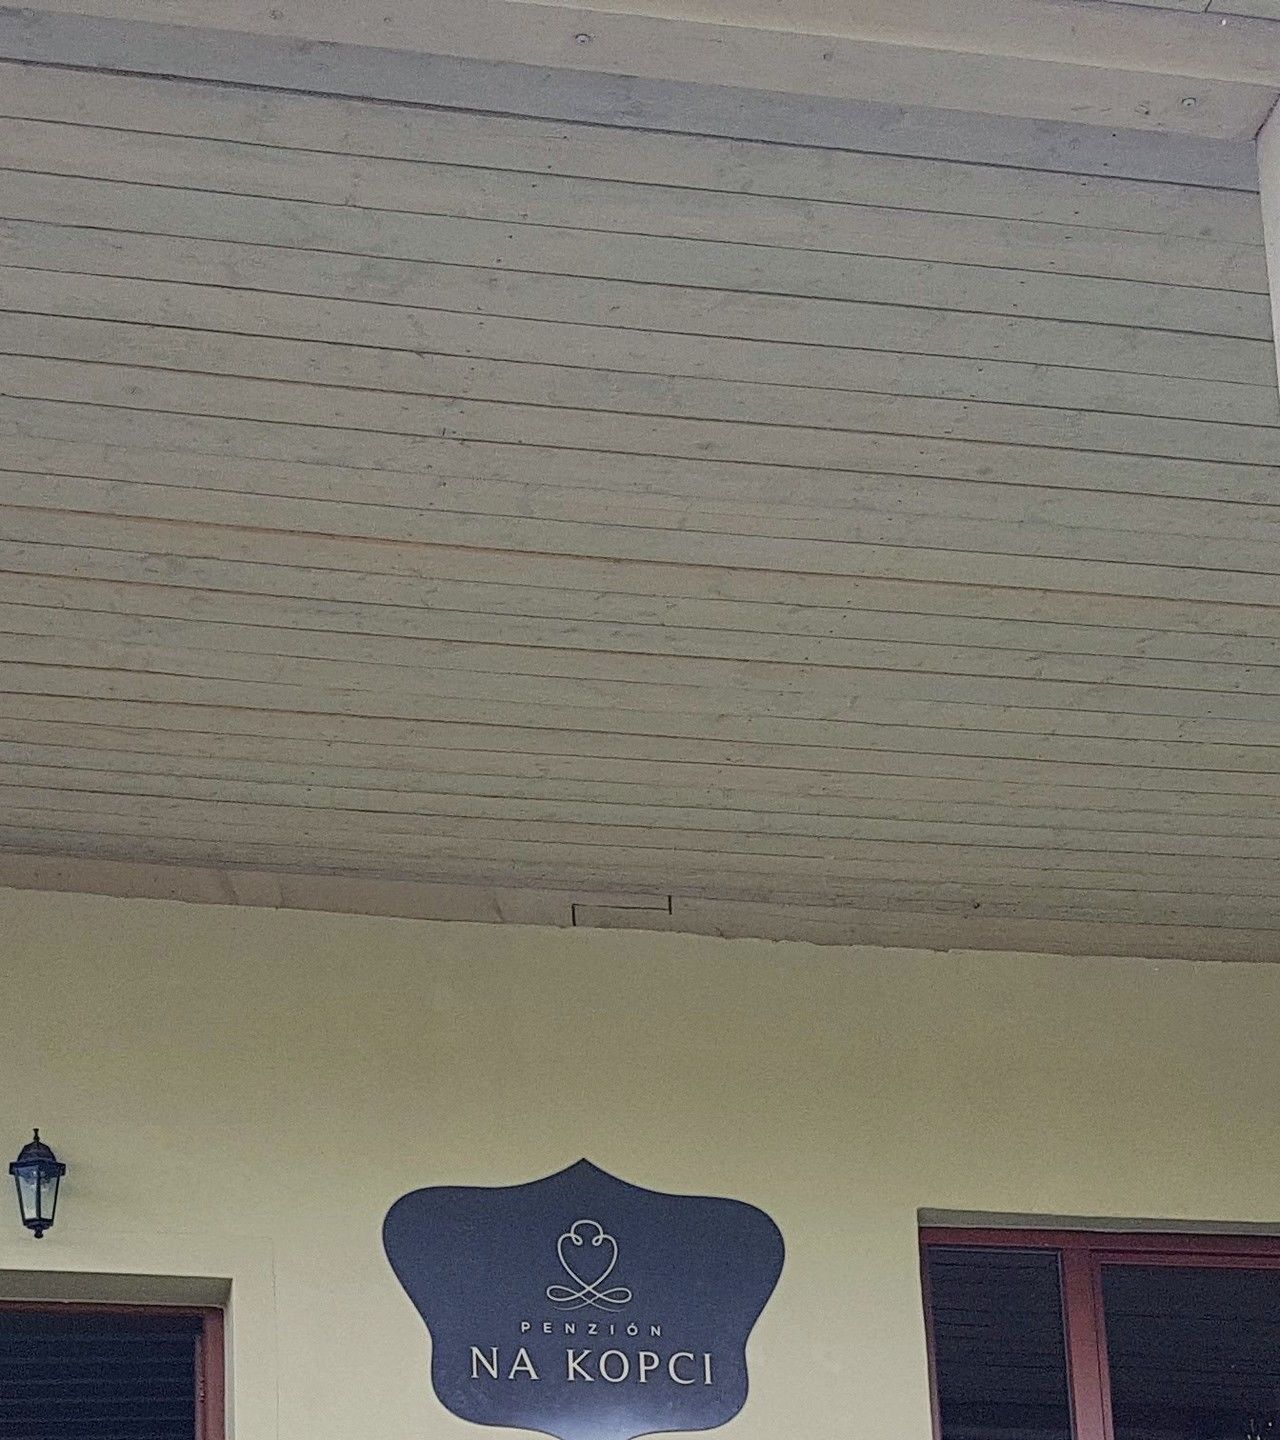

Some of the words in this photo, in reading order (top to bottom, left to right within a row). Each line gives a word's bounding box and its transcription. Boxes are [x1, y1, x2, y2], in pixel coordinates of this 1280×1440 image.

[521, 1321, 662, 1337] PENZIÓN
[470, 1346, 539, 1381] NA
[566, 1349, 714, 1385] KOPCI
